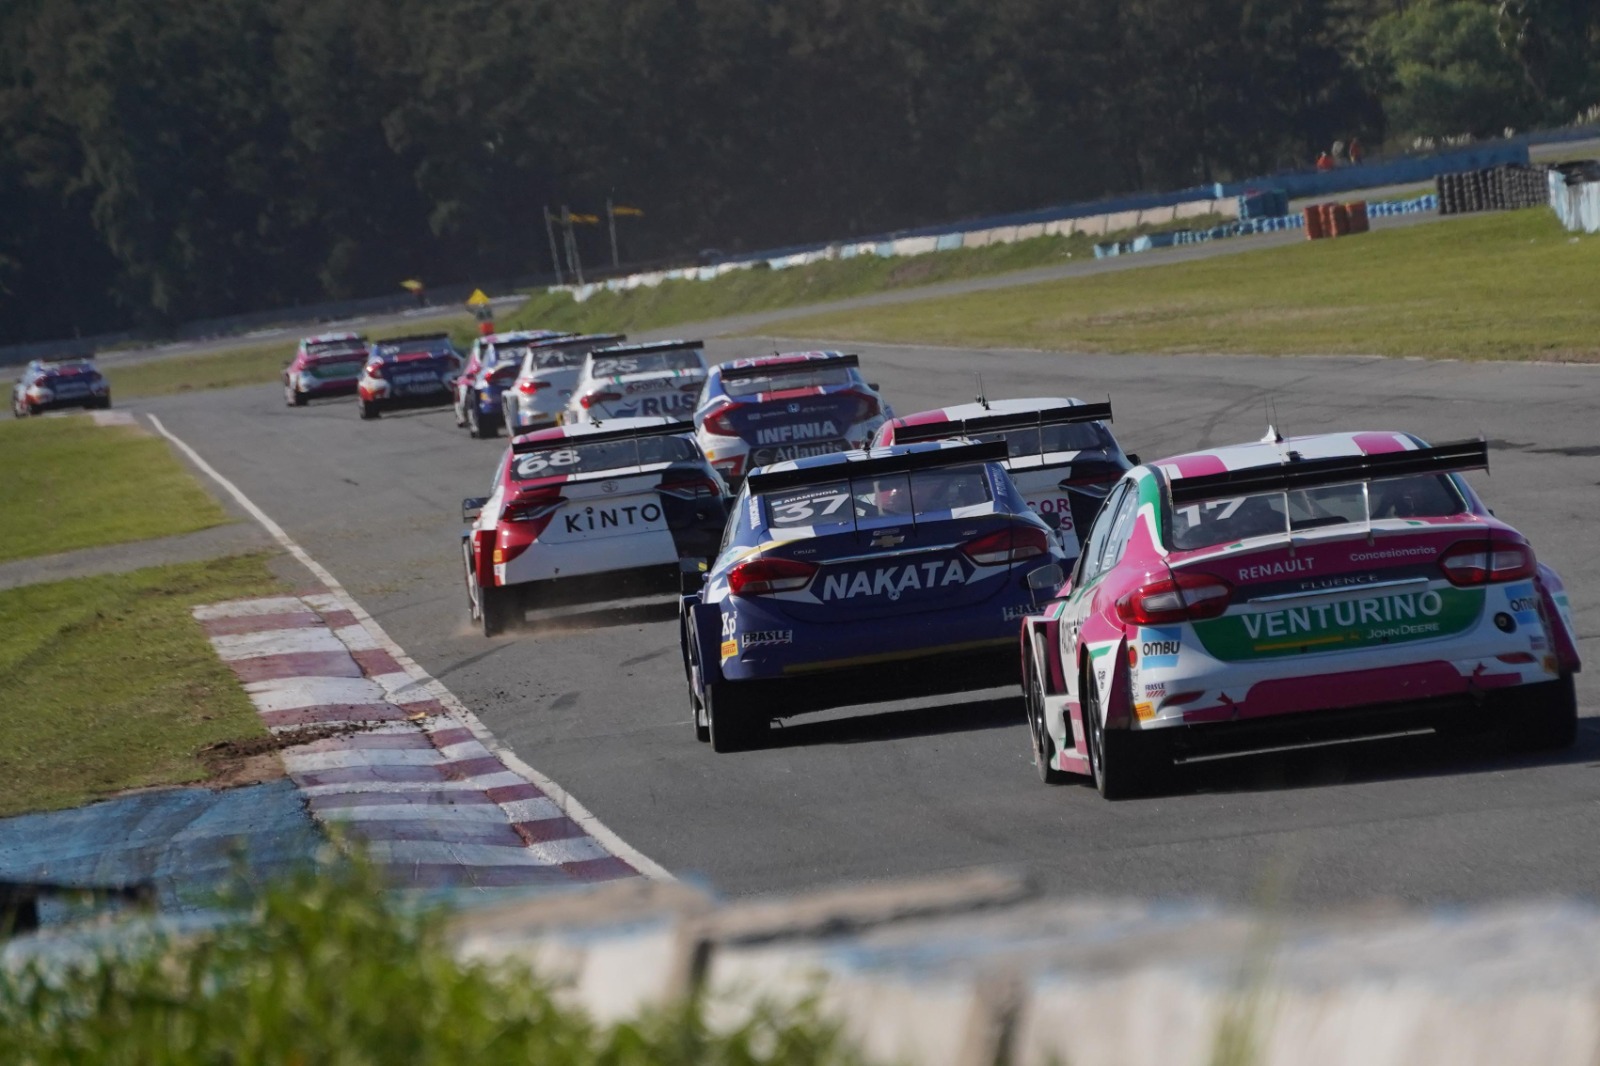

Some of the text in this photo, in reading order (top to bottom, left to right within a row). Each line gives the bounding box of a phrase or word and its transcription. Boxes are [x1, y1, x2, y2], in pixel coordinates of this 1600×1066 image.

[594, 359, 639, 379] 25
[756, 420, 840, 445] INFINIA
[517, 449, 582, 479] 68
[773, 441, 842, 463] Atlantis
[773, 493, 850, 523] 37
[783, 489, 839, 504] ARAMENDIA
[1177, 497, 1248, 527] 17
[1349, 545, 1438, 563] Concesionarios
[822, 558, 966, 601] NAKATA
[1238, 557, 1316, 582] RENAULT
[1300, 574, 1379, 590] FLUENCE
[1241, 589, 1444, 640] VENTURINO
[1366, 622, 1441, 640] JOHN DEERE
